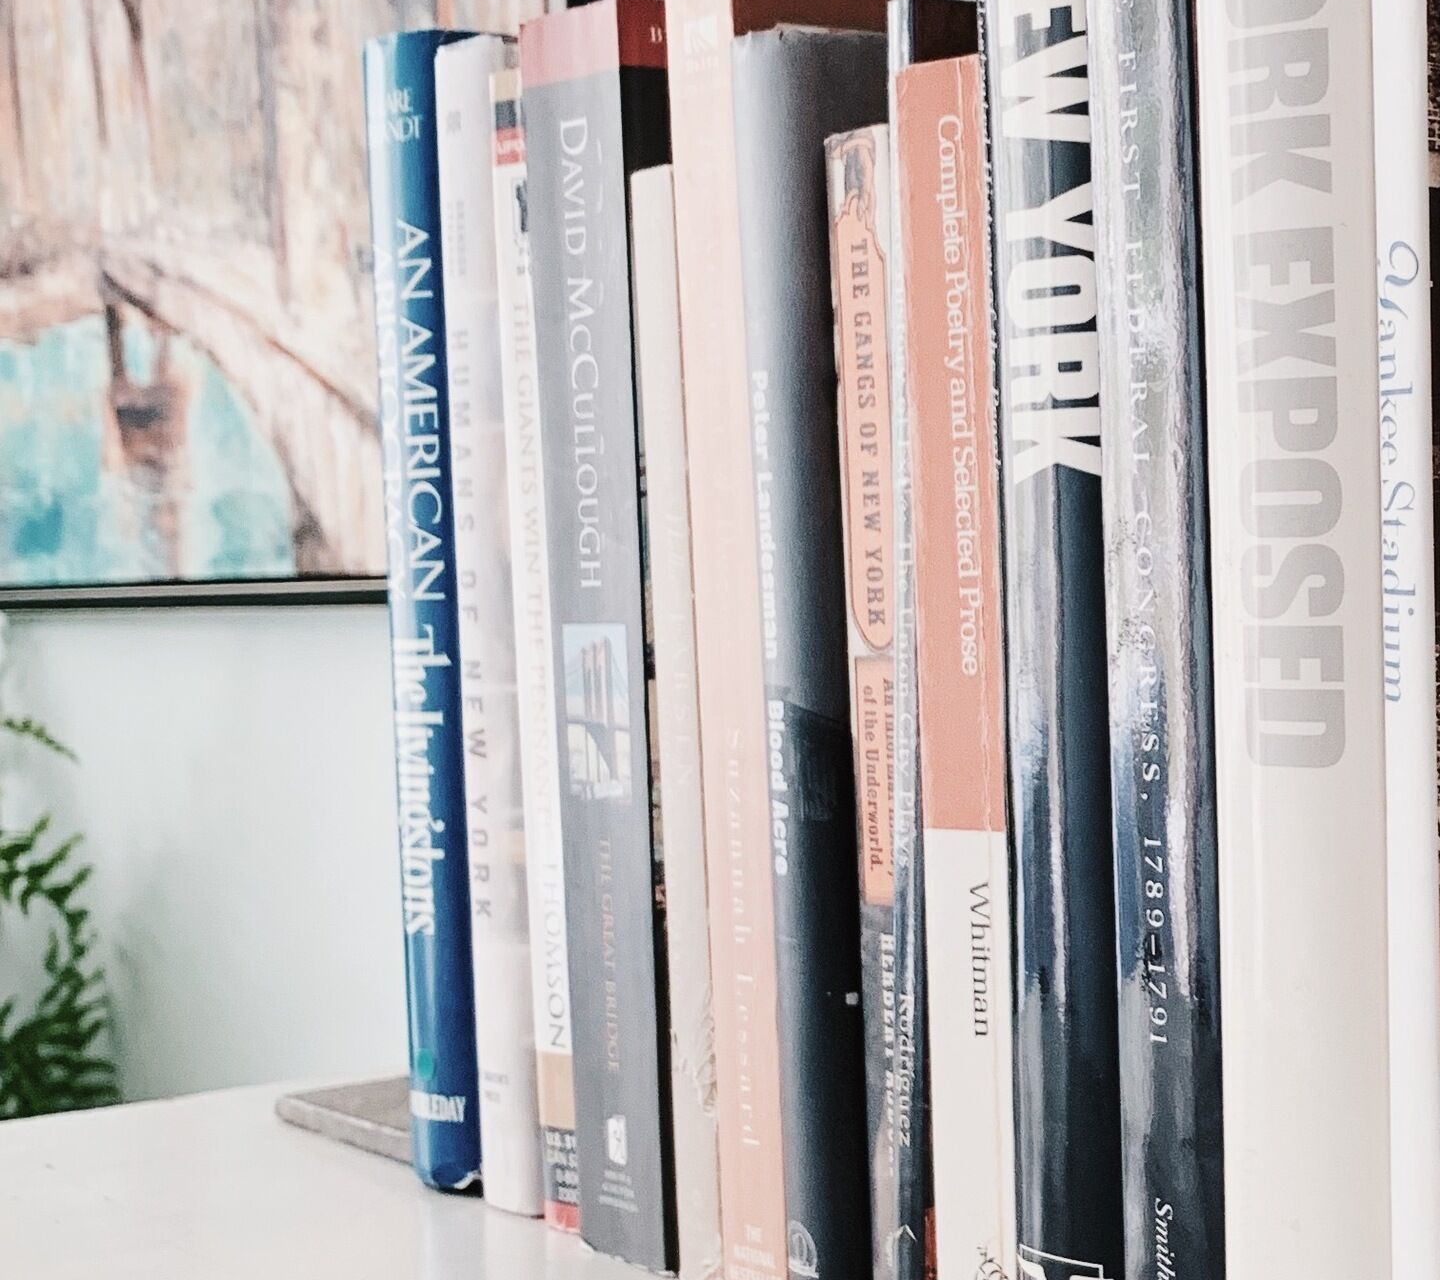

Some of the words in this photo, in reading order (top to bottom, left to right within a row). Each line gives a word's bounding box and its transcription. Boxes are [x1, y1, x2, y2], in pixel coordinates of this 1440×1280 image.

[1118, 50, 1141, 200] FIRST
[560, 117, 589, 255] DAVID
[936, 115, 967, 264] Complete
[396, 219, 433, 299] AN
[850, 238, 869, 298] THE
[513, 301, 532, 363] THE
[854, 310, 876, 410] GANGS
[943, 271, 970, 373] Poetry
[1005, 181, 1102, 484] YORK
[1124, 240, 1150, 473] FEDERAL
[1379, 240, 1420, 466] Yankee
[451, 329, 474, 532] HUMANS
[516, 374, 538, 497] GIANTS
[751, 371, 772, 461] Peter
[859, 422, 878, 456] OF
[950, 378, 973, 439] and
[399, 318, 446, 601] AMERICAN
[861, 471, 882, 534] NEW
[1233, 226, 1346, 769] EXPOSED
[524, 506, 542, 575] WIN
[953, 446, 981, 579] Selected
[460, 571, 478, 624] OF
[756, 471, 778, 660] Landesman
[864, 545, 886, 627] YORK
[1381, 479, 1417, 703] Stadium
[393, 624, 452, 704] The
[527, 588, 545, 654] THE
[959, 586, 982, 675] Prose
[1134, 510, 1161, 801] CONGRESS,
[464, 659, 488, 759] NEW
[767, 699, 788, 780] Blood
[863, 685, 876, 707] of
[865, 710, 878, 741] the
[470, 794, 492, 918] YORK
[771, 798, 790, 876] Acre
[866, 748, 884, 871] Underworld.
[969, 881, 990, 1038] Whitman
[604, 980, 621, 1072] BRIDGE
[896, 993, 917, 1147] Rodriguez
